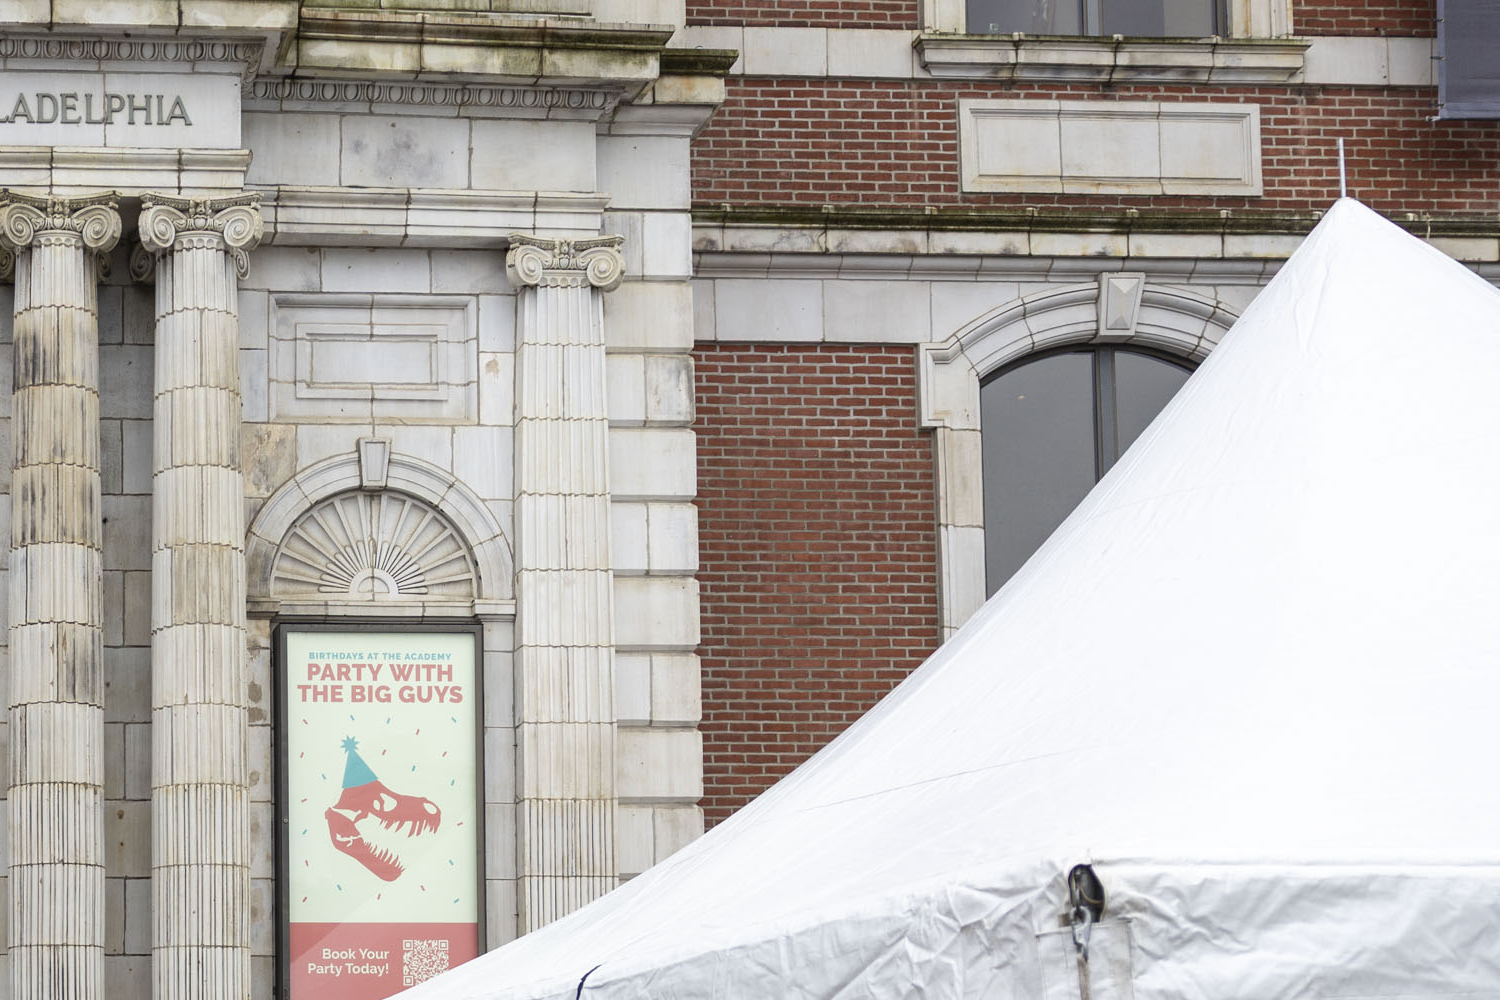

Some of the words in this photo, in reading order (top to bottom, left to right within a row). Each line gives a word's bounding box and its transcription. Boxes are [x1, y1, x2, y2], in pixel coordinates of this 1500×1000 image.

[309, 651, 364, 660] BIRTHDAYS
[367, 652, 379, 660] AT
[383, 652, 402, 661] THE
[404, 653, 452, 661] ACADEMY
[307, 663, 383, 682] PARTY
[389, 664, 453, 682] WITH
[297, 684, 344, 703] THE
[351, 685, 392, 703] BIG
[398, 685, 464, 704] GUYS
[322, 948, 356, 960] Book
[359, 948, 390, 960] Your
[307, 962, 342, 977] Party
[345, 963, 389, 977] Today!
